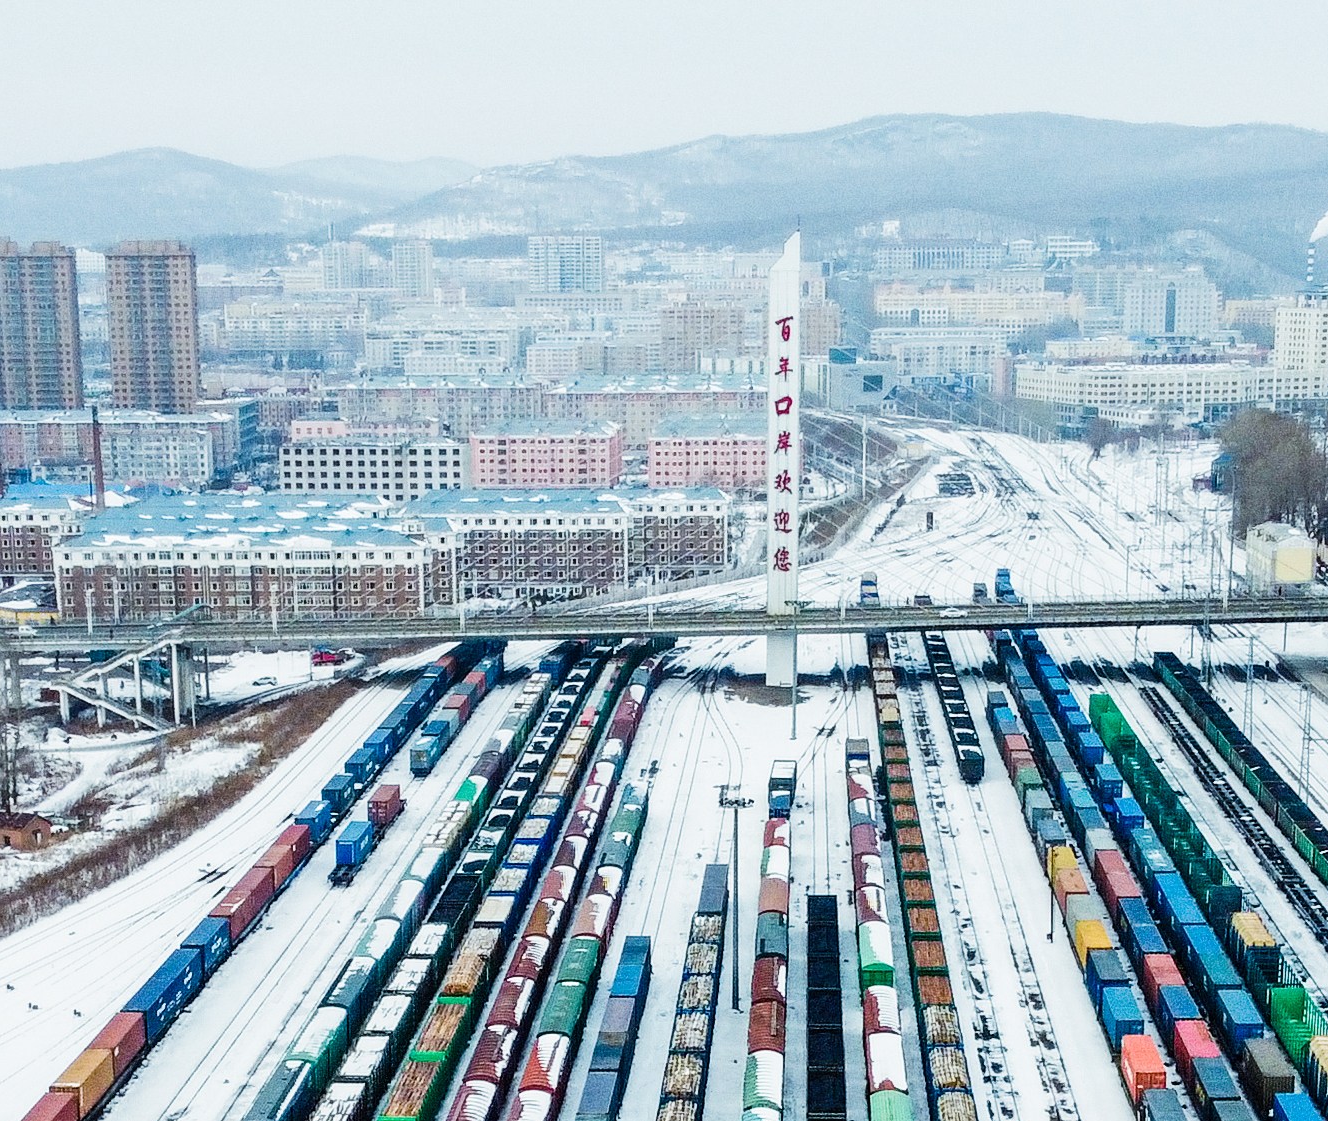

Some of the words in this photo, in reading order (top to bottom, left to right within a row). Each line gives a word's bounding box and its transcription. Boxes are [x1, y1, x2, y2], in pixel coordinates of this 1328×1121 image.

[774, 315, 794, 572] 百年口岸欢迎您
